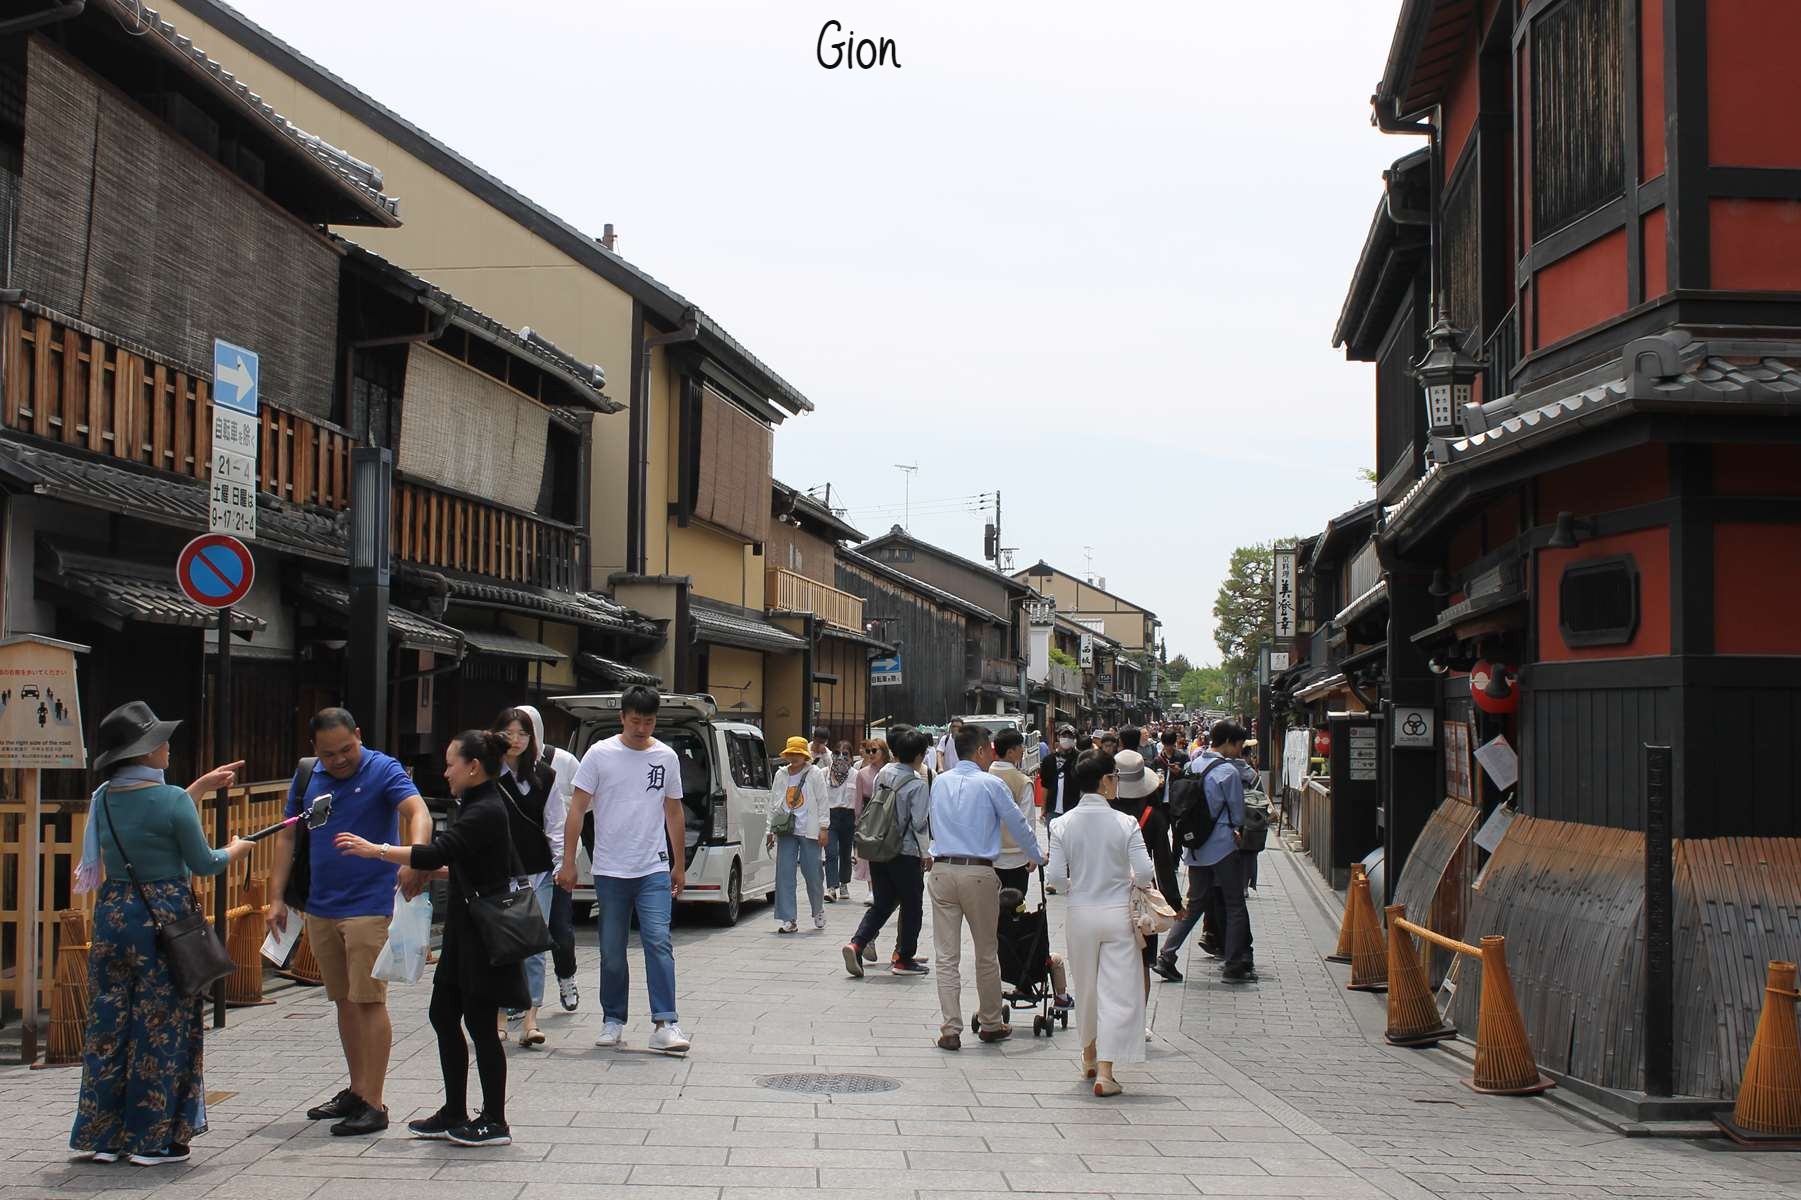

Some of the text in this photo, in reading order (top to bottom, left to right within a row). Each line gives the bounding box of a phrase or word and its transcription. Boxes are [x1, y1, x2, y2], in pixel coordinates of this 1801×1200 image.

[215, 417, 255, 449] 自転車を除く
